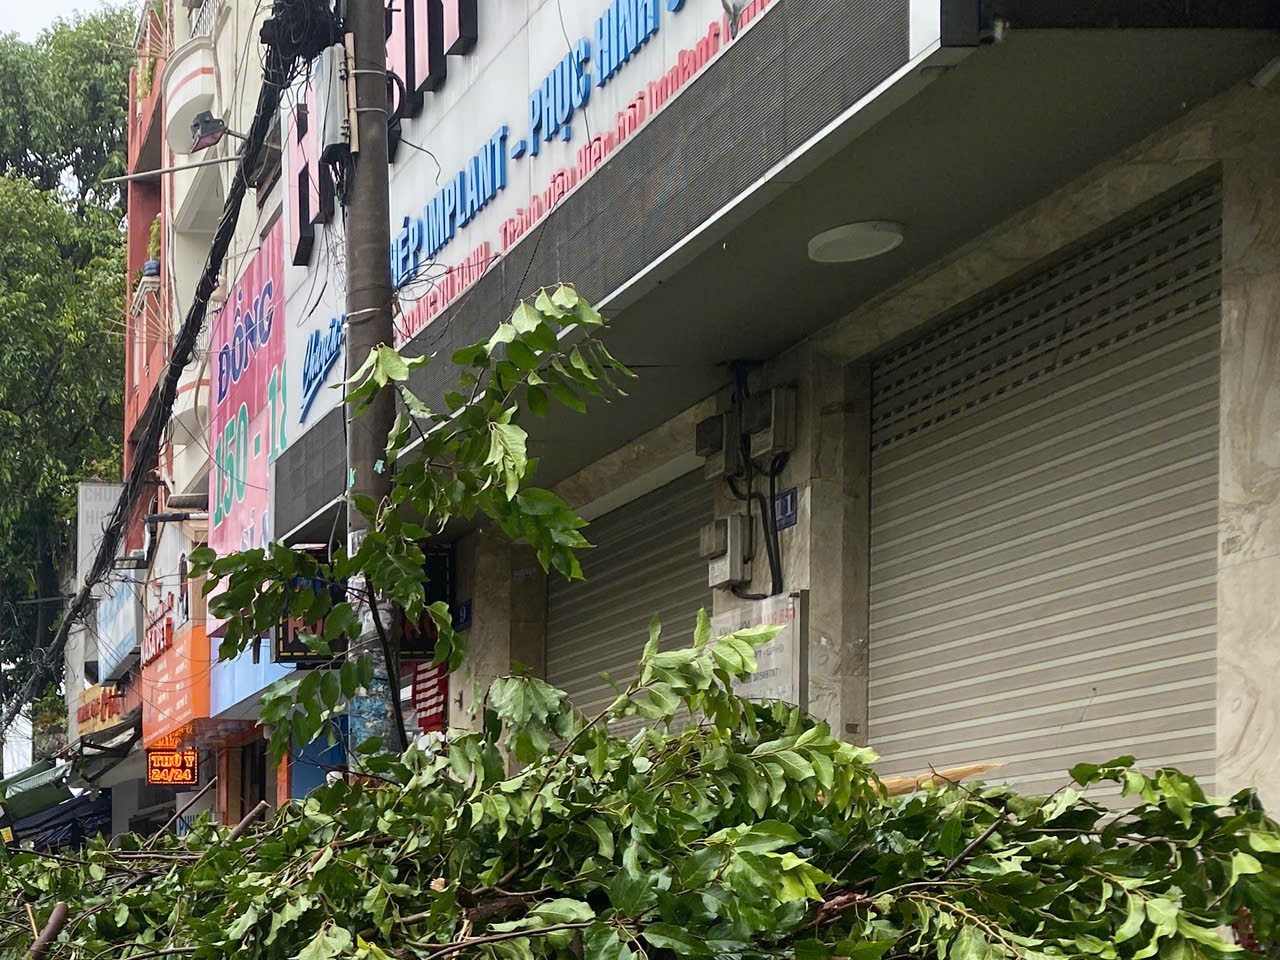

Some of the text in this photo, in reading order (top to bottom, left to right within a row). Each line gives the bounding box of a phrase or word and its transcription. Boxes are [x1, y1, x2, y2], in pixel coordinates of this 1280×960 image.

[424, 125, 508, 260] IMPLANT
[528, 37, 590, 157] PHỤC
[214, 402, 249, 531] 150
[151, 768, 192, 783] 24/24
